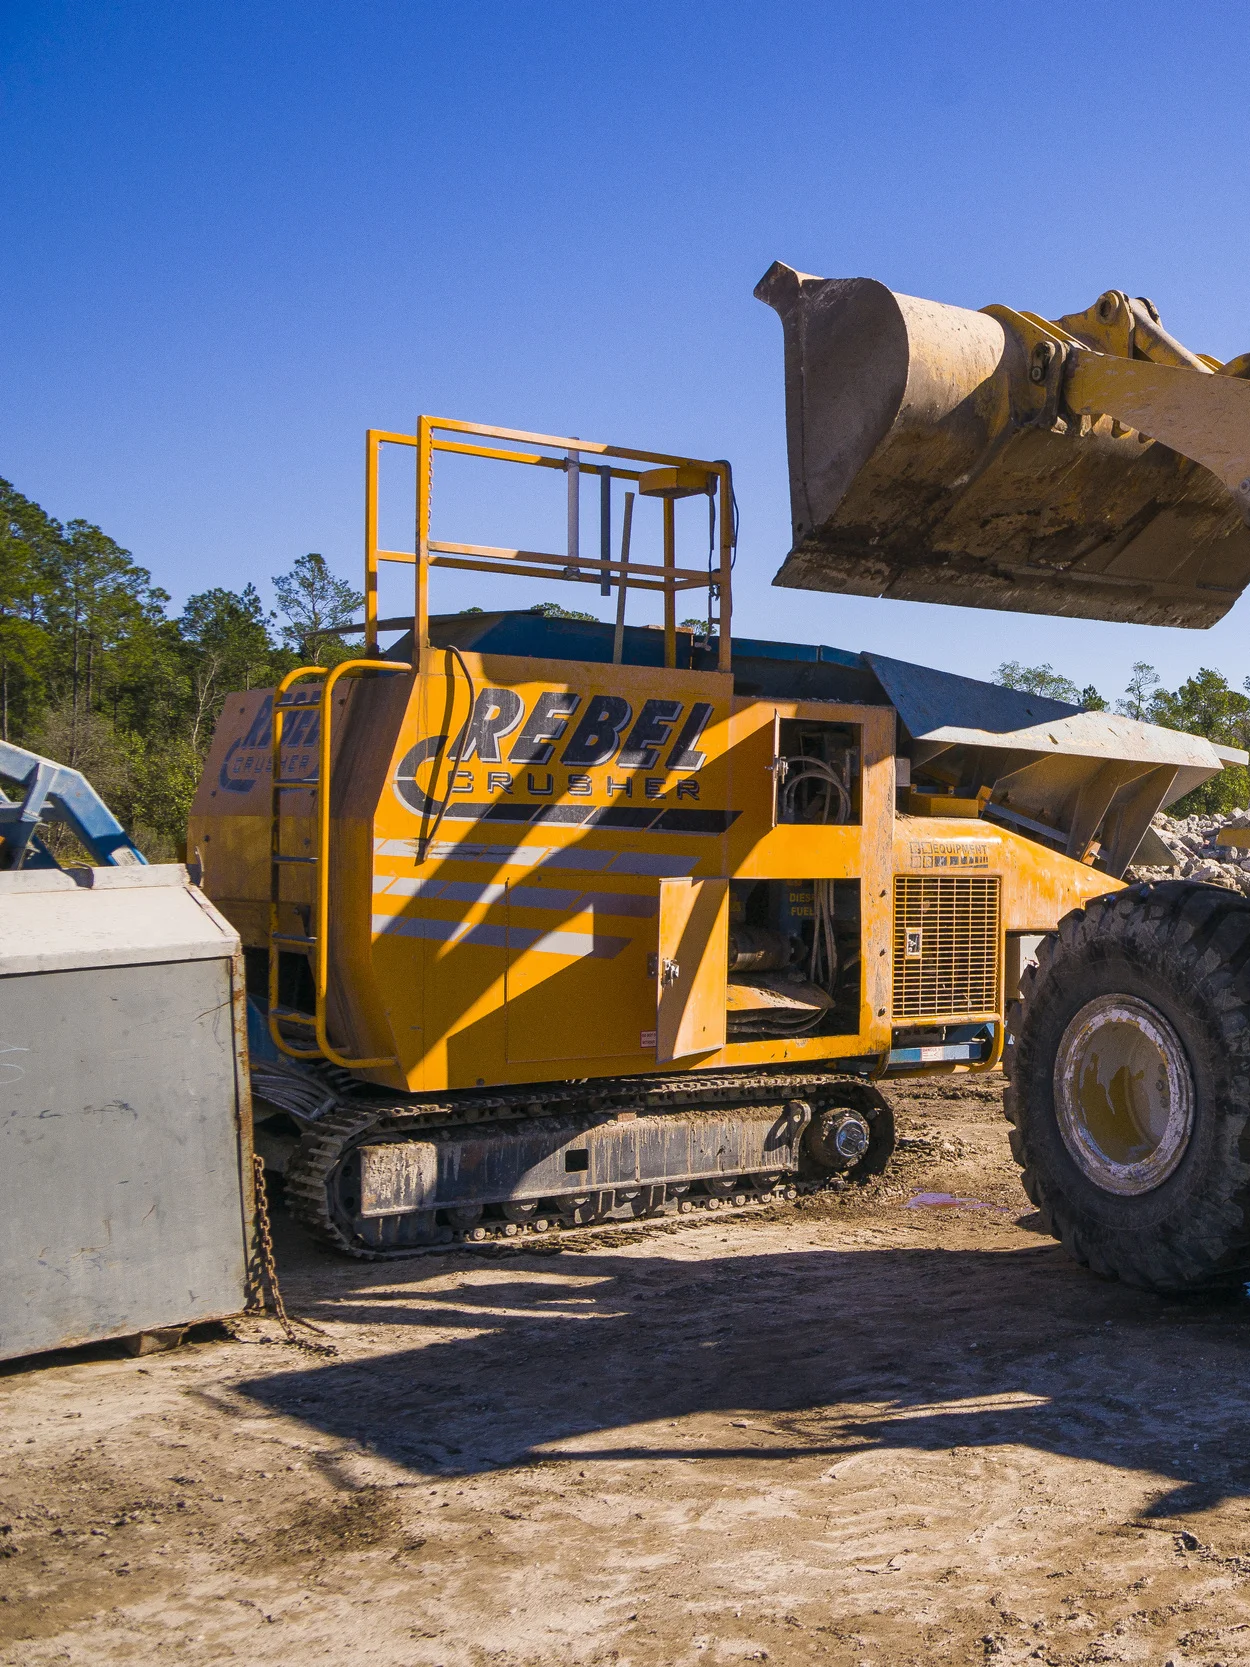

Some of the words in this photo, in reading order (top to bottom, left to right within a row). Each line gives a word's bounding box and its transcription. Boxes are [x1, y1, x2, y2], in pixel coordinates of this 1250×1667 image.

[447, 687, 714, 772] REBEL
[448, 770, 701, 801] CRUSHER
[933, 843, 988, 855] EQUIPMENT
[789, 892, 815, 903] DIES
[791, 906, 815, 917] FUEL
